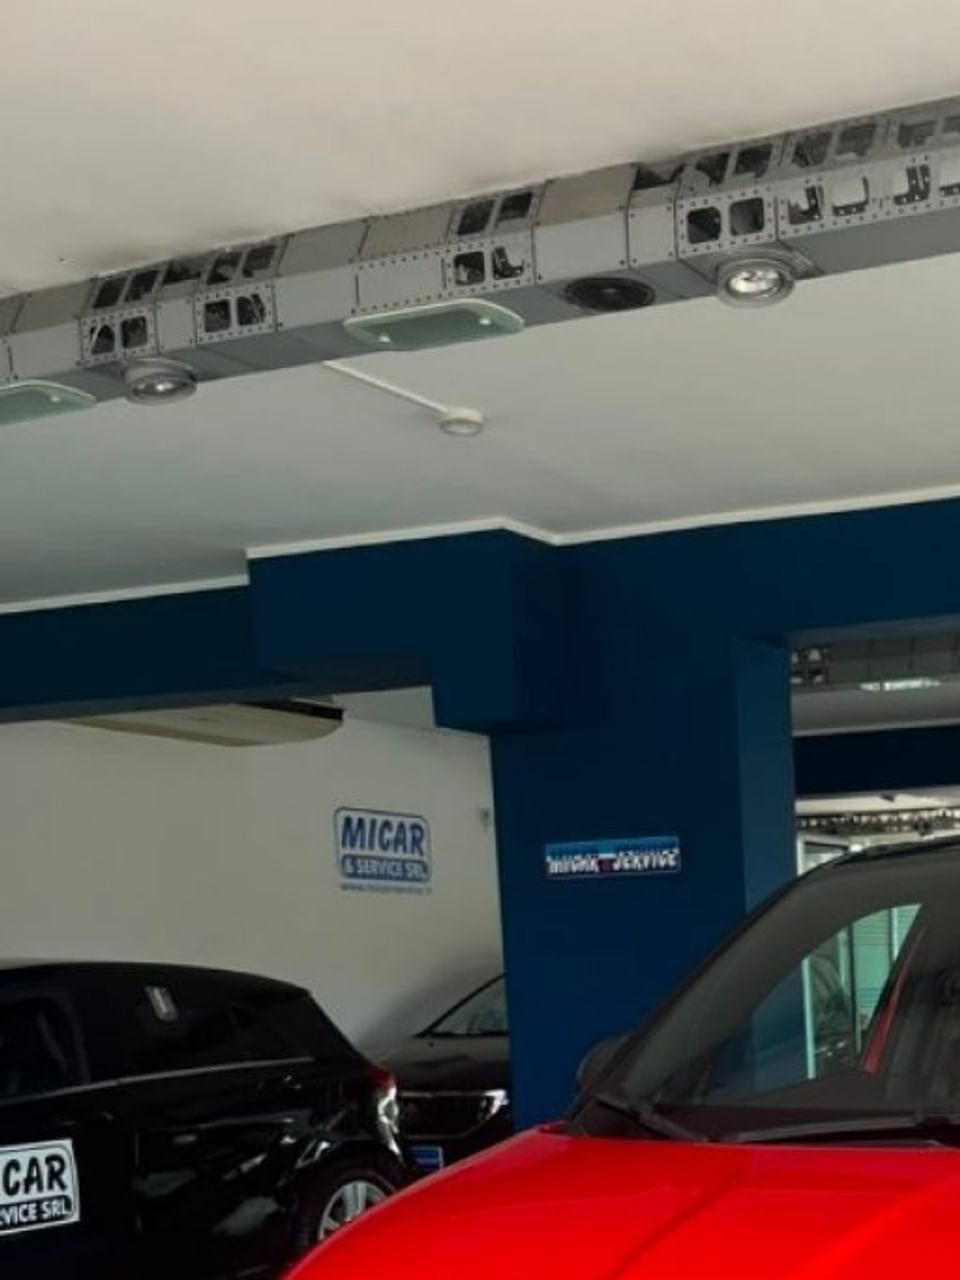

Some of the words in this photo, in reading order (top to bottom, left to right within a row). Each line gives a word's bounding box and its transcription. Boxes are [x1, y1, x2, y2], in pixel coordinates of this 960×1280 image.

[341, 816, 424, 856] MICAR
[356, 859, 403, 877] SERVICE
[0, 1203, 37, 1227] VICE
[42, 1199, 69, 1219] SRL
